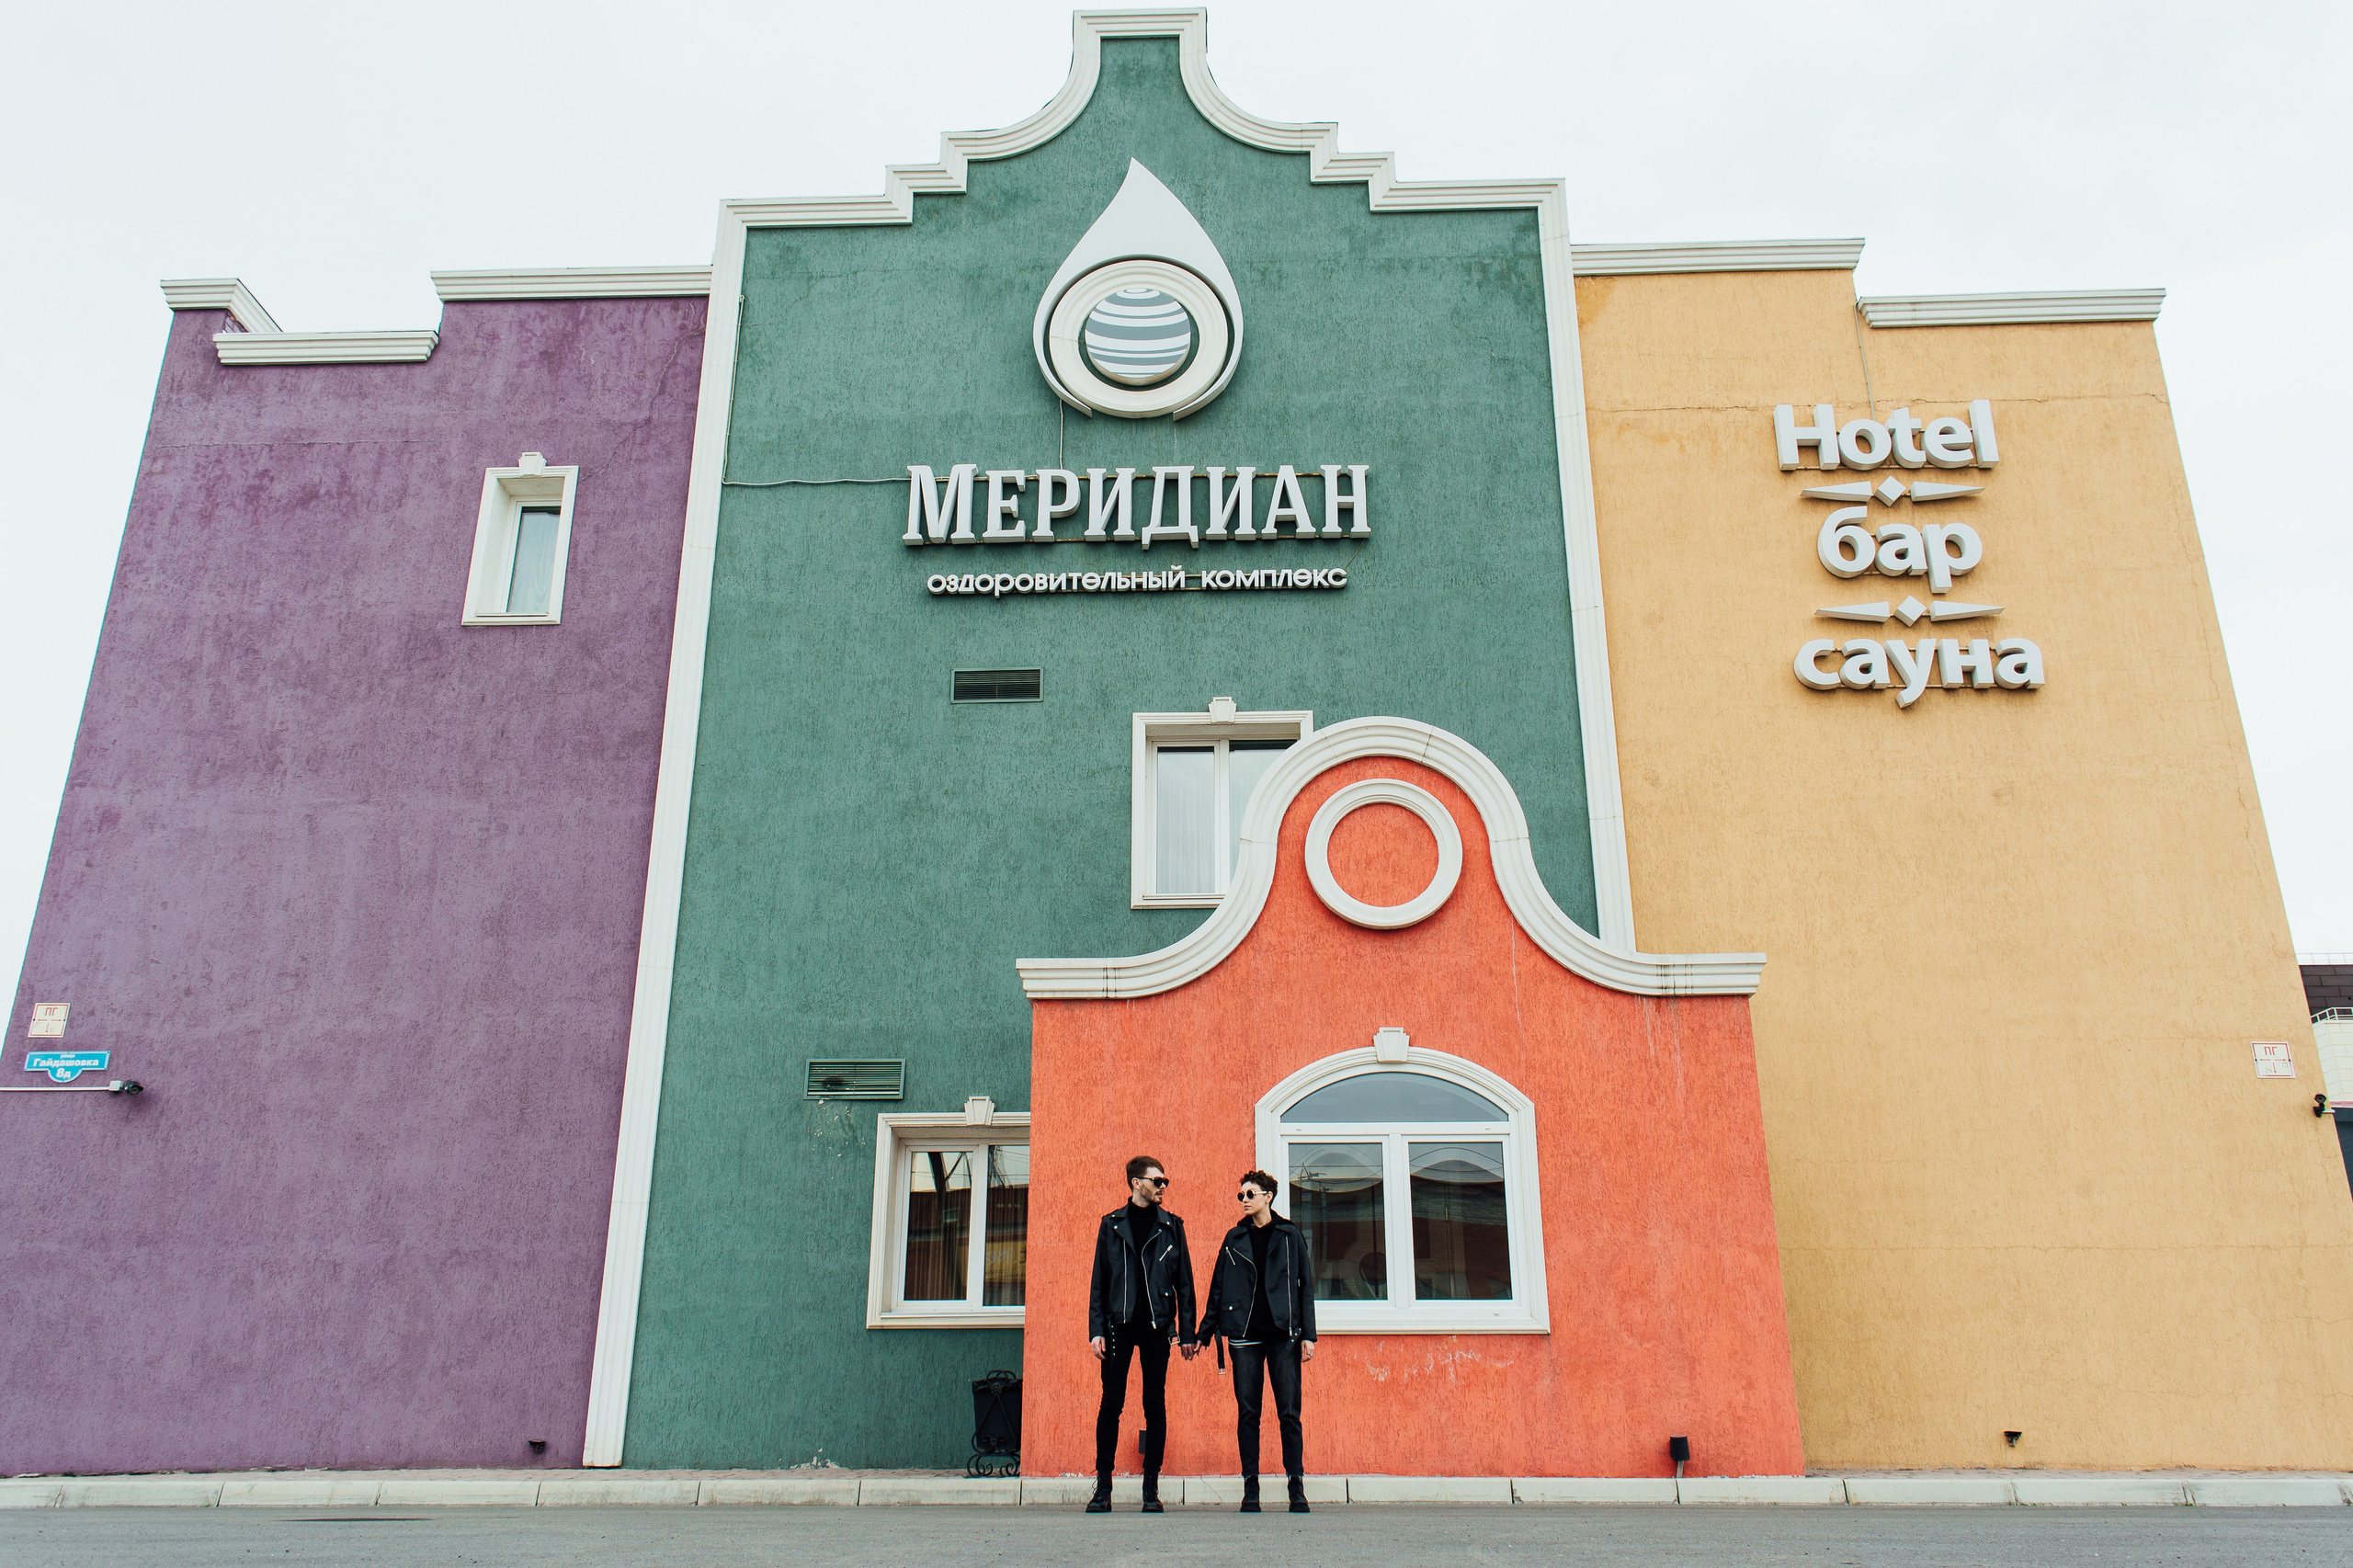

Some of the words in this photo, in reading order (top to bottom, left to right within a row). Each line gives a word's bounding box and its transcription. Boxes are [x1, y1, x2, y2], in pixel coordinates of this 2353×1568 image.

[1773, 399, 2000, 471] Hotel
[1817, 506, 1983, 594] бар
[927, 565, 1186, 598] оздоровительный
[1201, 568, 1348, 589] комплекс
[1793, 638, 2046, 710] сауна
[45, 1007, 58, 1016] ПГ
[2264, 1046, 2277, 1055] ПГ
[33, 1058, 99, 1067] Гайдашовка
[56, 1067, 72, 1079] 8д
